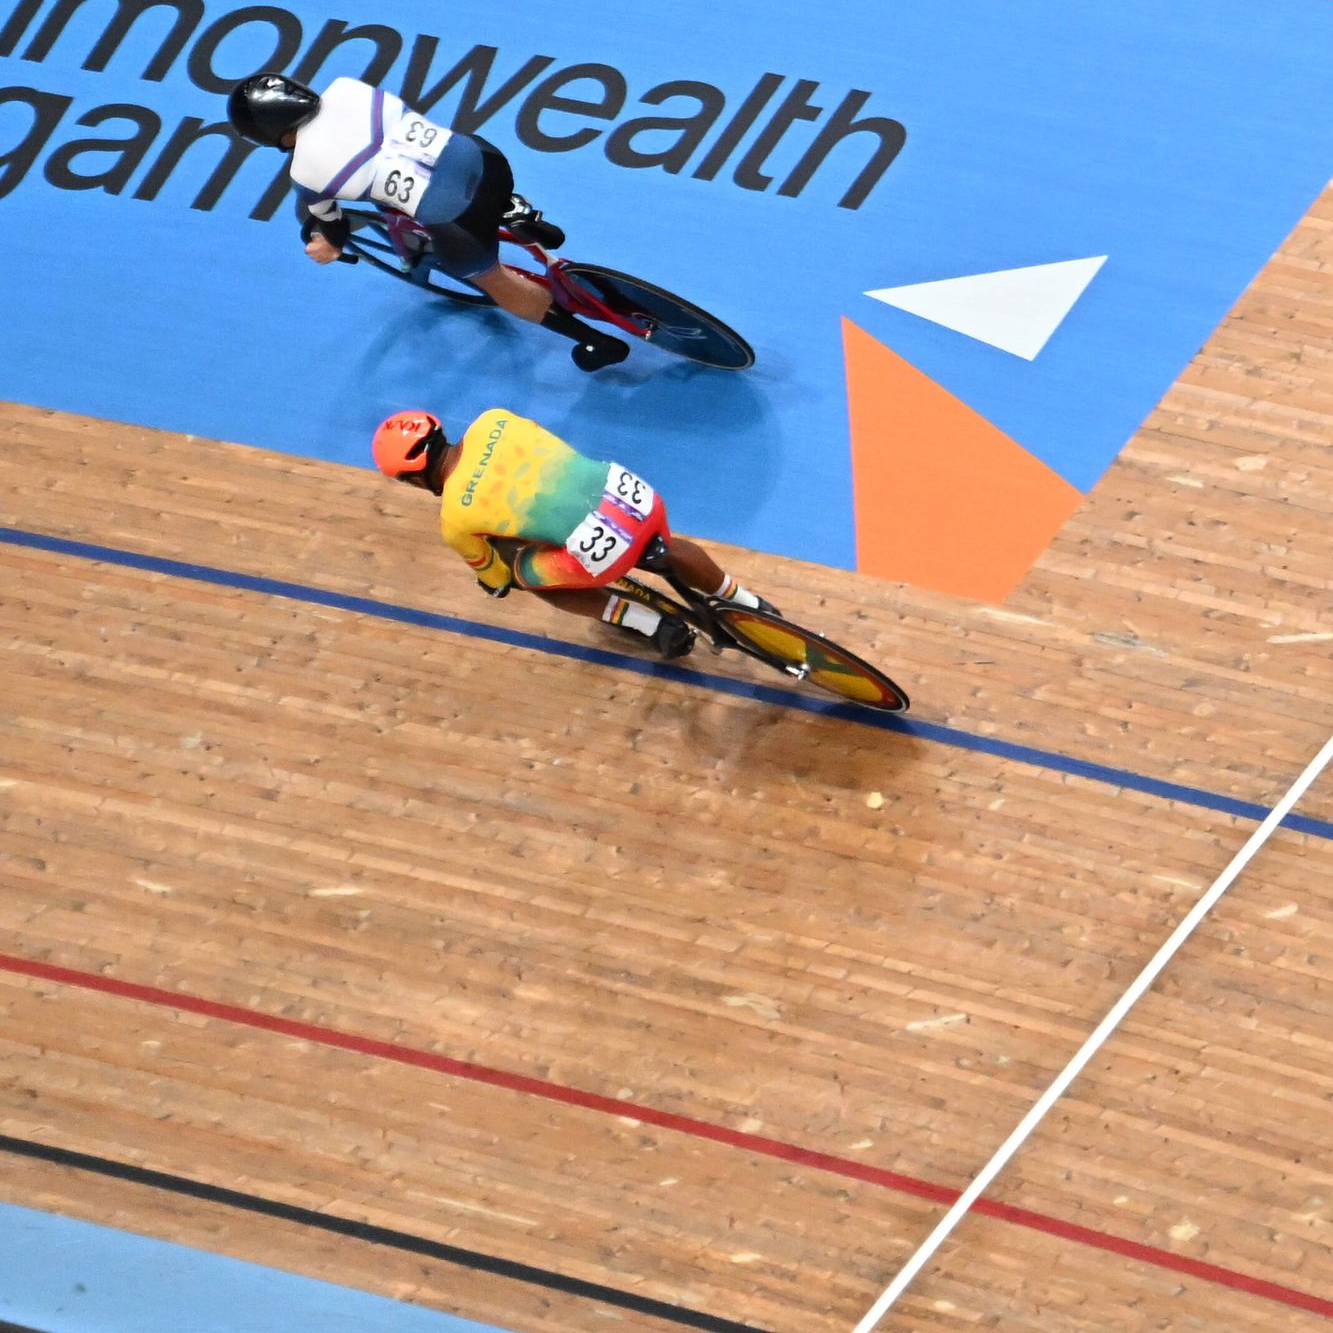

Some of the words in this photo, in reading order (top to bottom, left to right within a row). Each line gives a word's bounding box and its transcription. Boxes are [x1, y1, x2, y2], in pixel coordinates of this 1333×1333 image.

[409, 120, 438, 148] 63
[384, 169, 415, 203] 63
[460, 418, 508, 508] GRENADA
[614, 471, 645, 504] 33
[579, 525, 617, 563] 33
